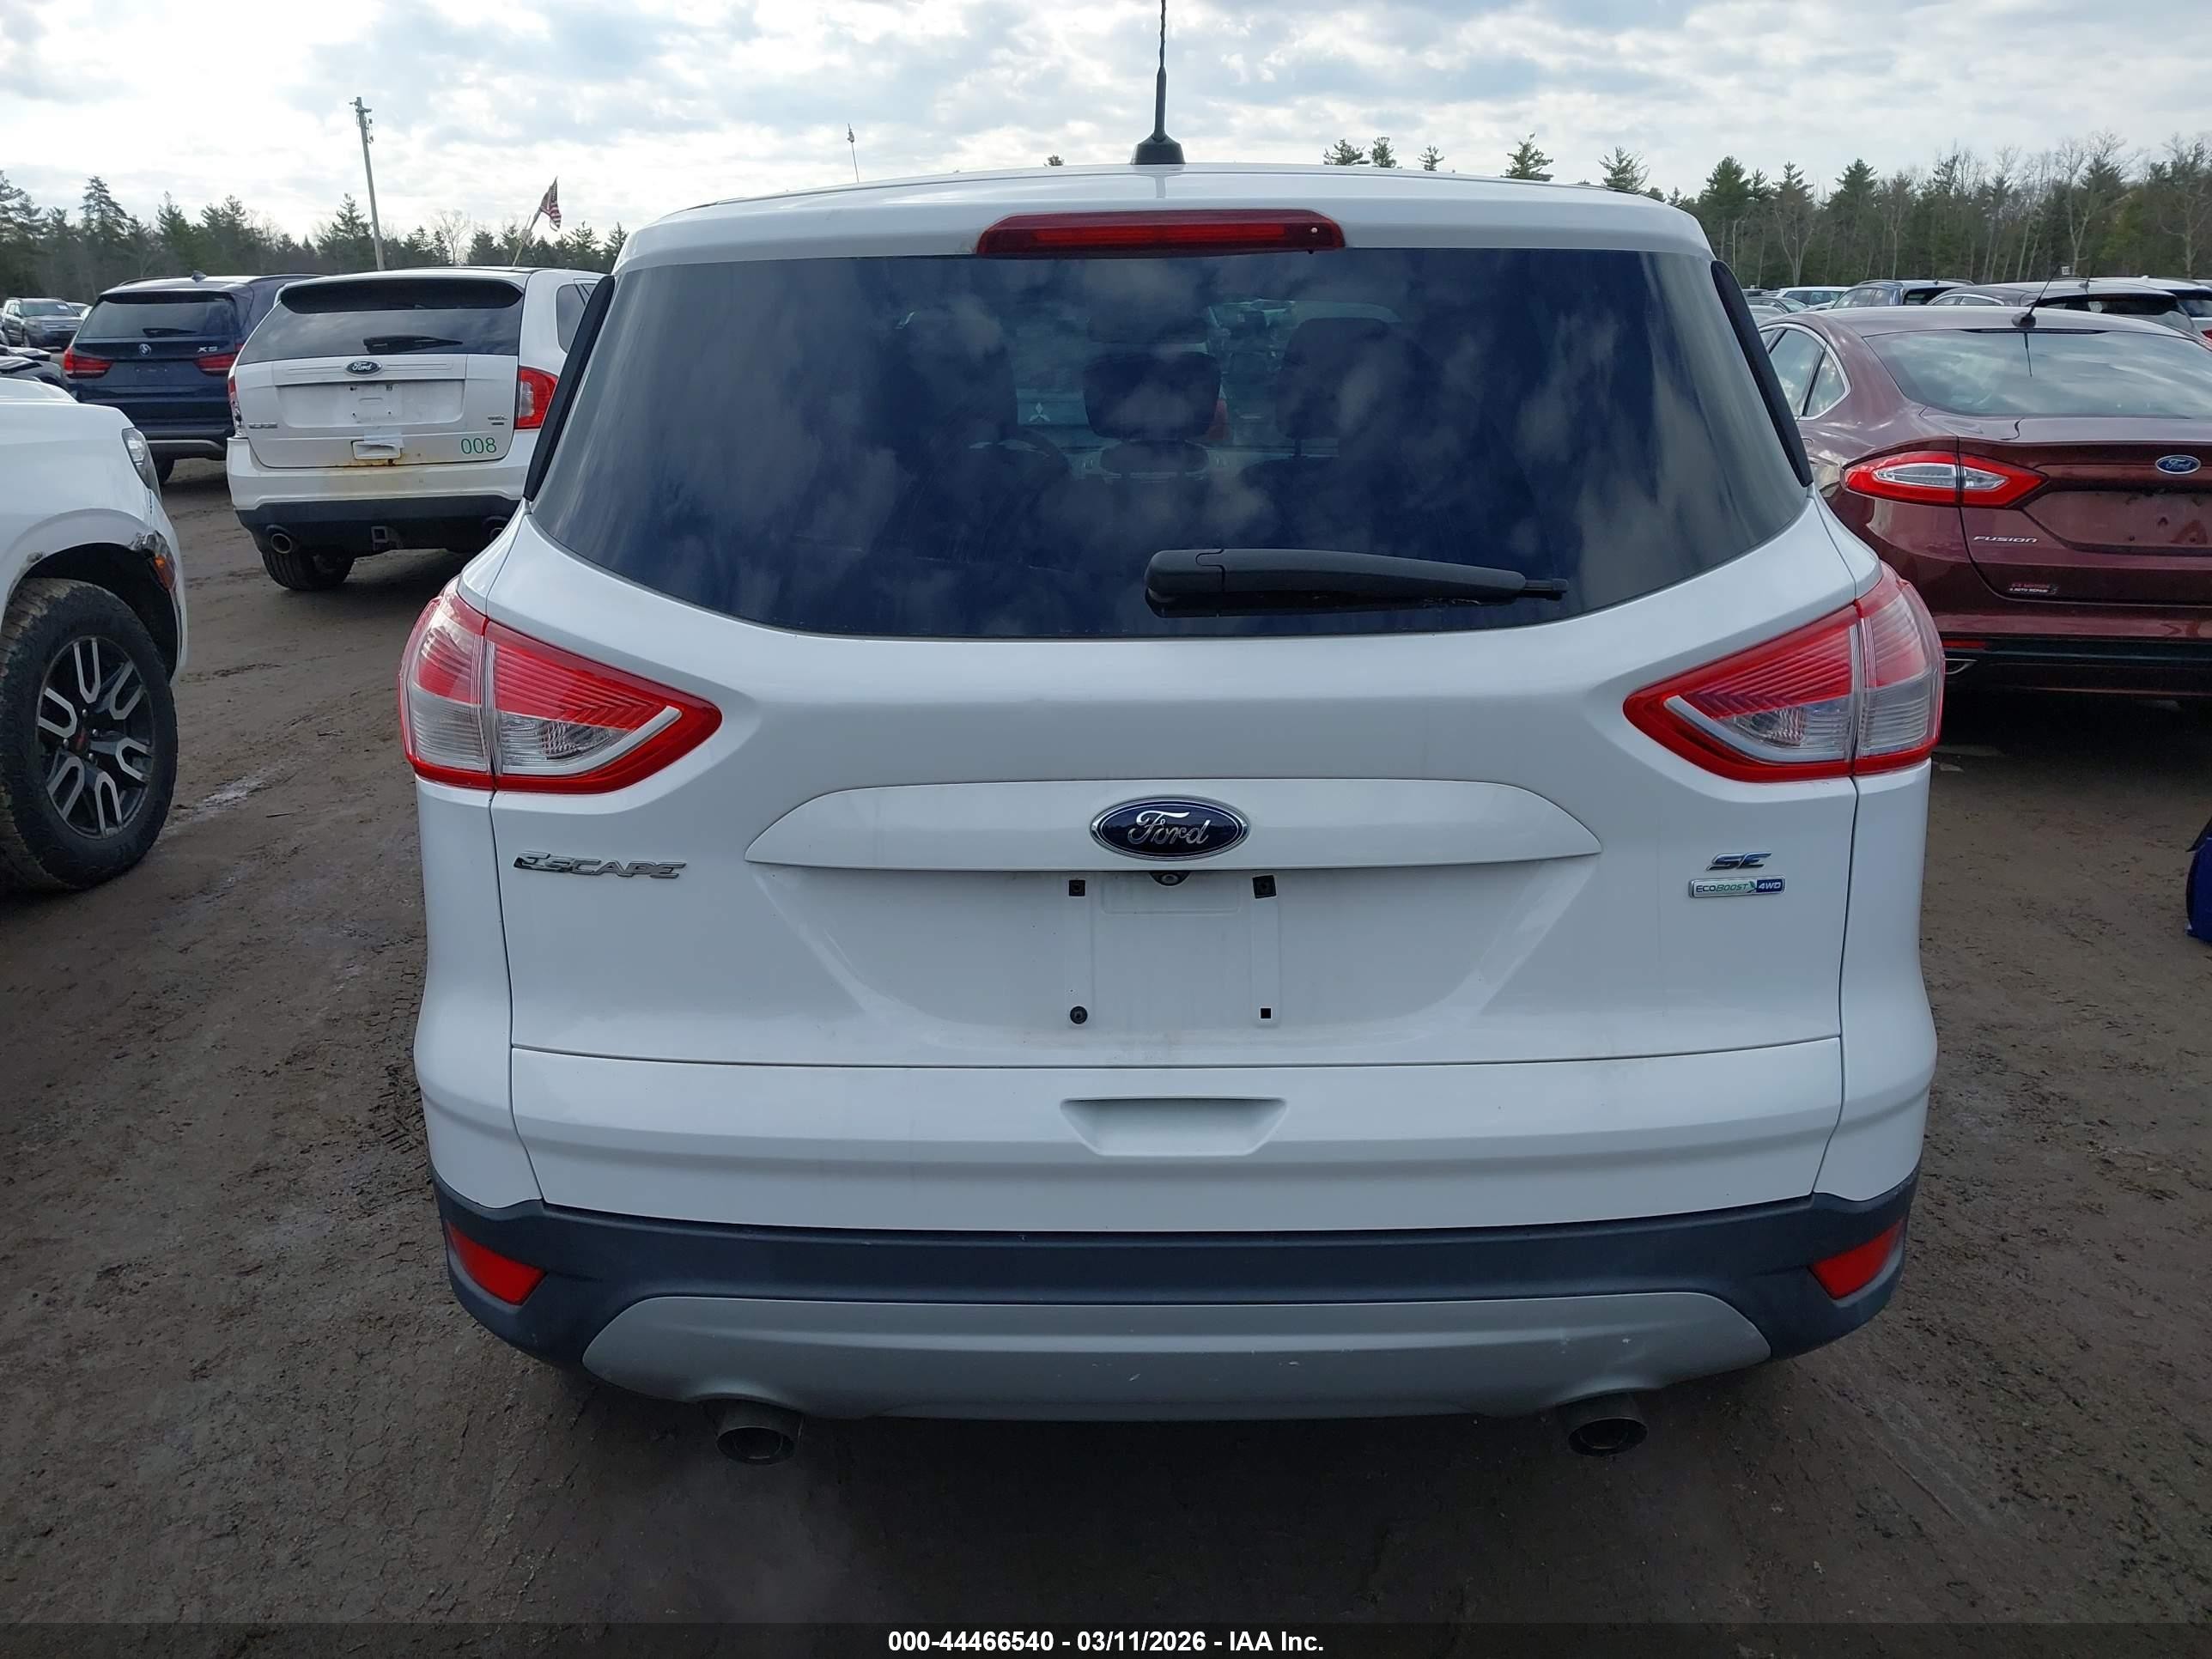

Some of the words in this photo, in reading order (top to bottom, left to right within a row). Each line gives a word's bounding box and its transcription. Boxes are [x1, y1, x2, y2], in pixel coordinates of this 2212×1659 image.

[460, 437, 497, 454] 008
[1127, 809, 1212, 846] Ford
[514, 850, 687, 879] ESCAPE
[1705, 852, 1772, 872] SE
[1695, 882, 1749, 894] ECOBOOST
[1758, 881, 1782, 890] 4WD
